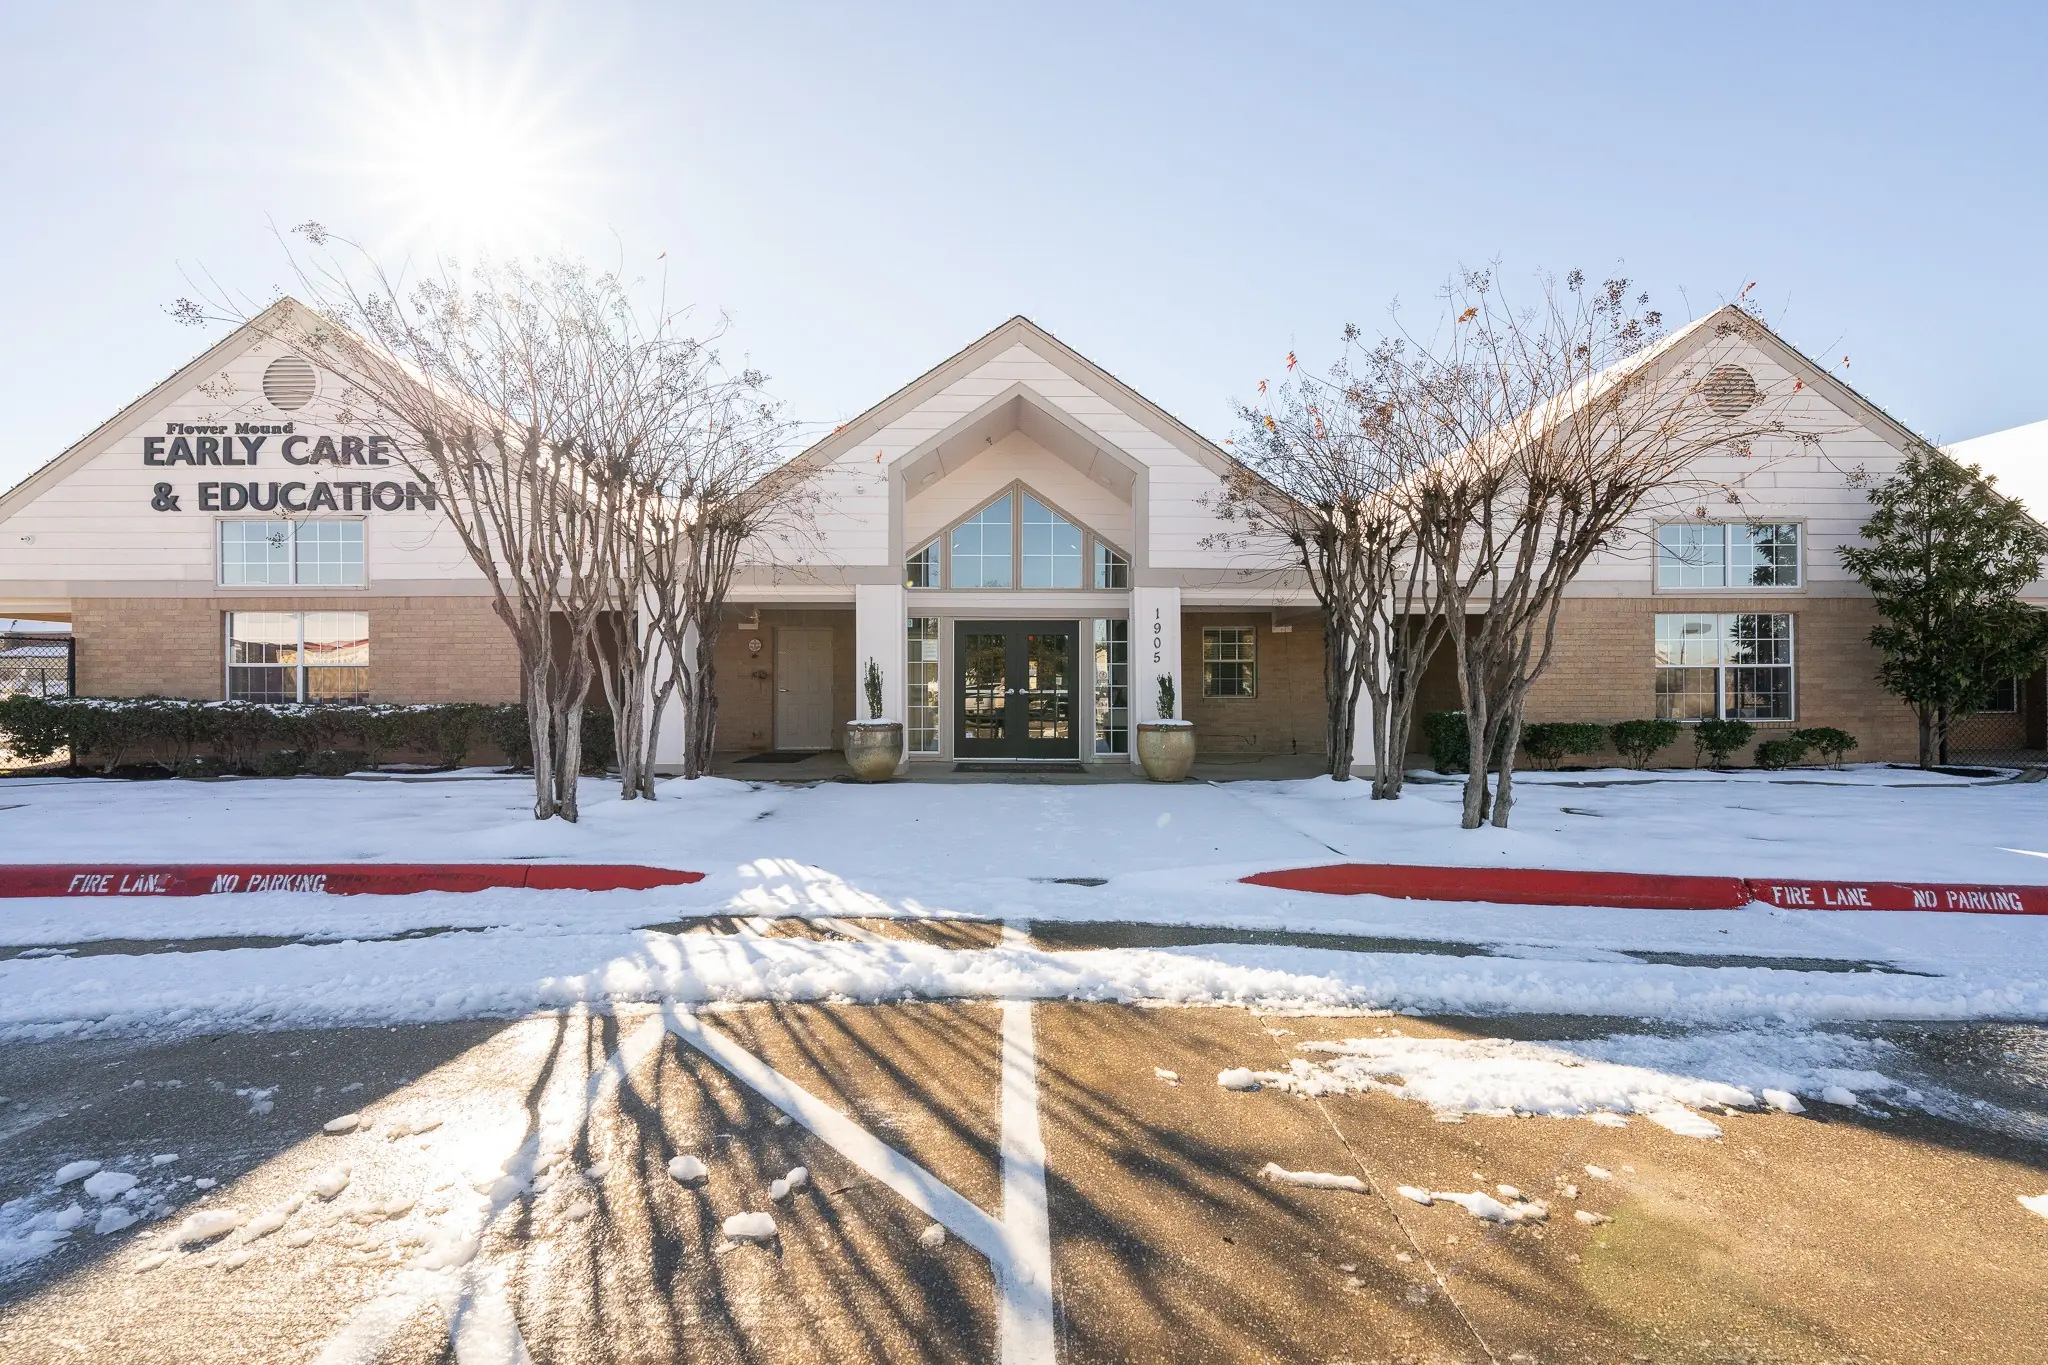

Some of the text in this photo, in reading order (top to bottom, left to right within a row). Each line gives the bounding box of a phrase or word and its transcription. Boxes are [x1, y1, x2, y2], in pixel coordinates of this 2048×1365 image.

[166, 422, 294, 435] Flower Mound
[143, 435, 390, 465] EARLY CARE
[151, 481, 436, 511] & EDUCATION
[1152, 607, 1162, 664] 1905
[67, 874, 114, 893] FIRE
[211, 874, 240, 893] NO
[246, 874, 326, 893] PARKING
[1772, 886, 2024, 911] FIRE LANE NO PARKING
